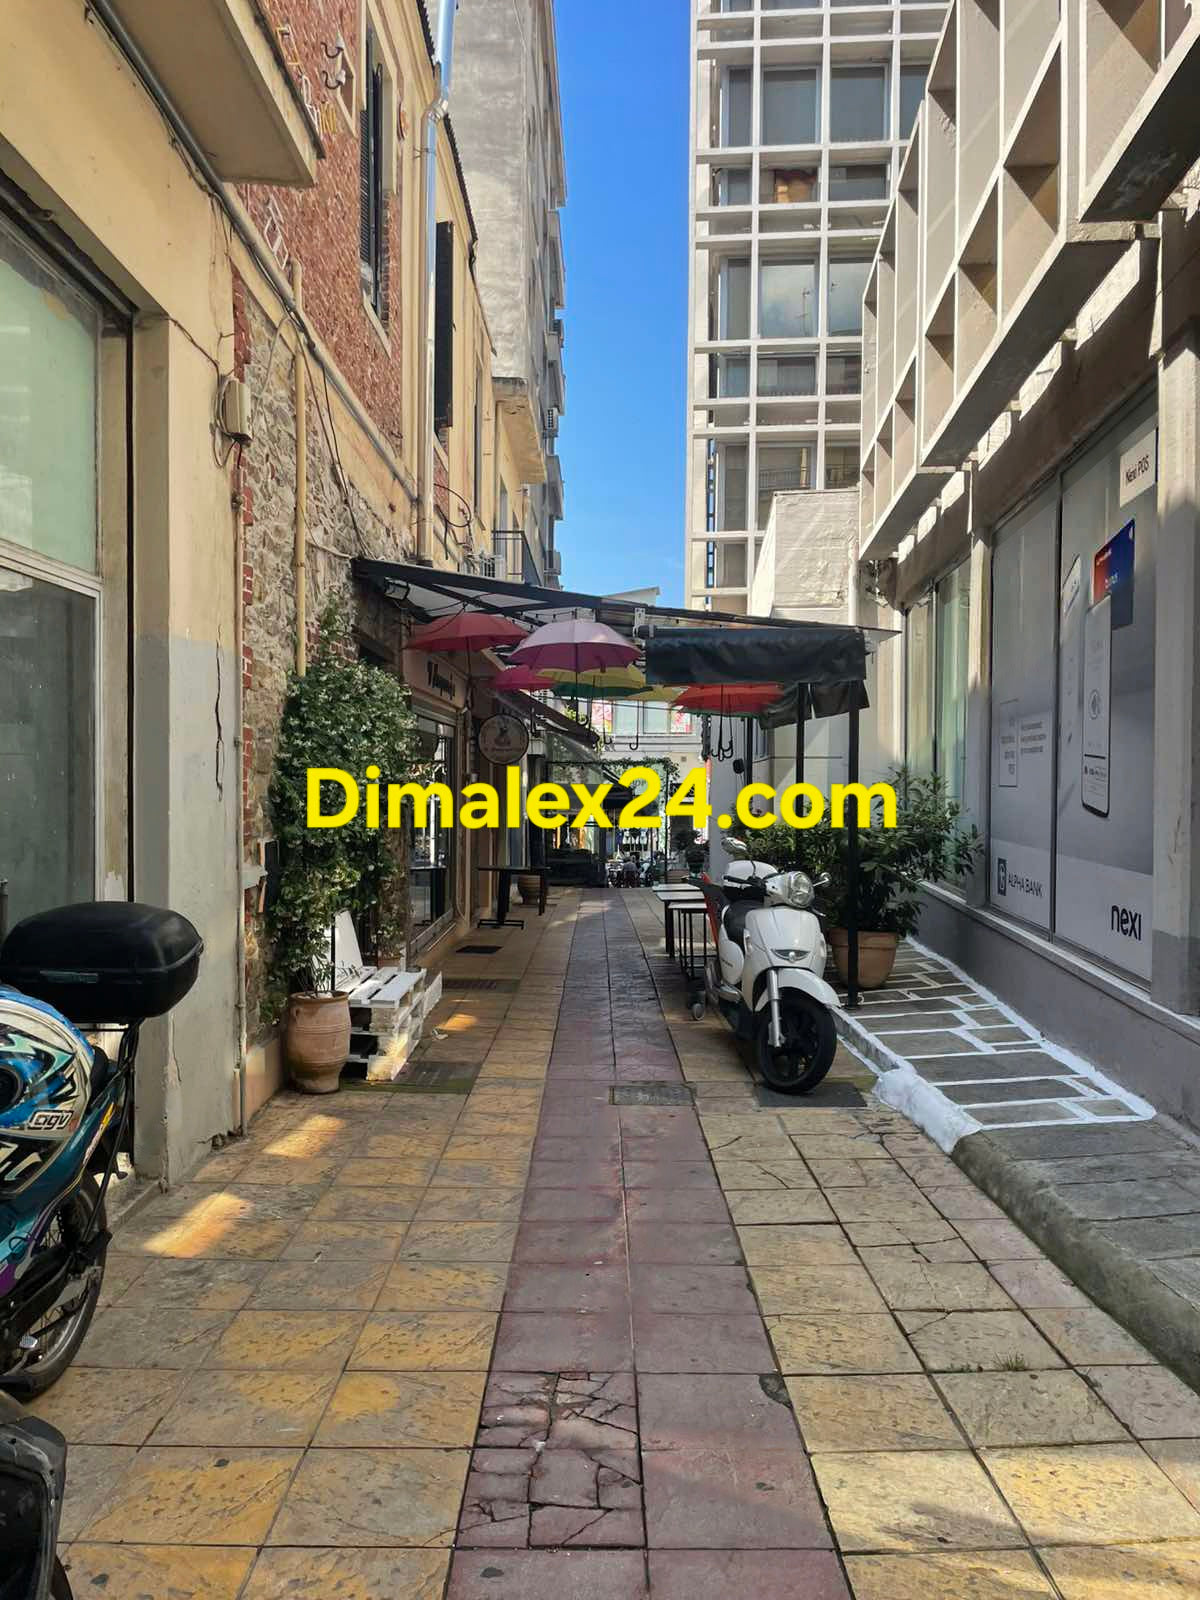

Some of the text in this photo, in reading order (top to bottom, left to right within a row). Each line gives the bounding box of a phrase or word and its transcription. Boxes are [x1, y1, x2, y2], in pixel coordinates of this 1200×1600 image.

[1008, 872, 1042, 897] ALPHA BANK
[1111, 905, 1142, 941] nexi
